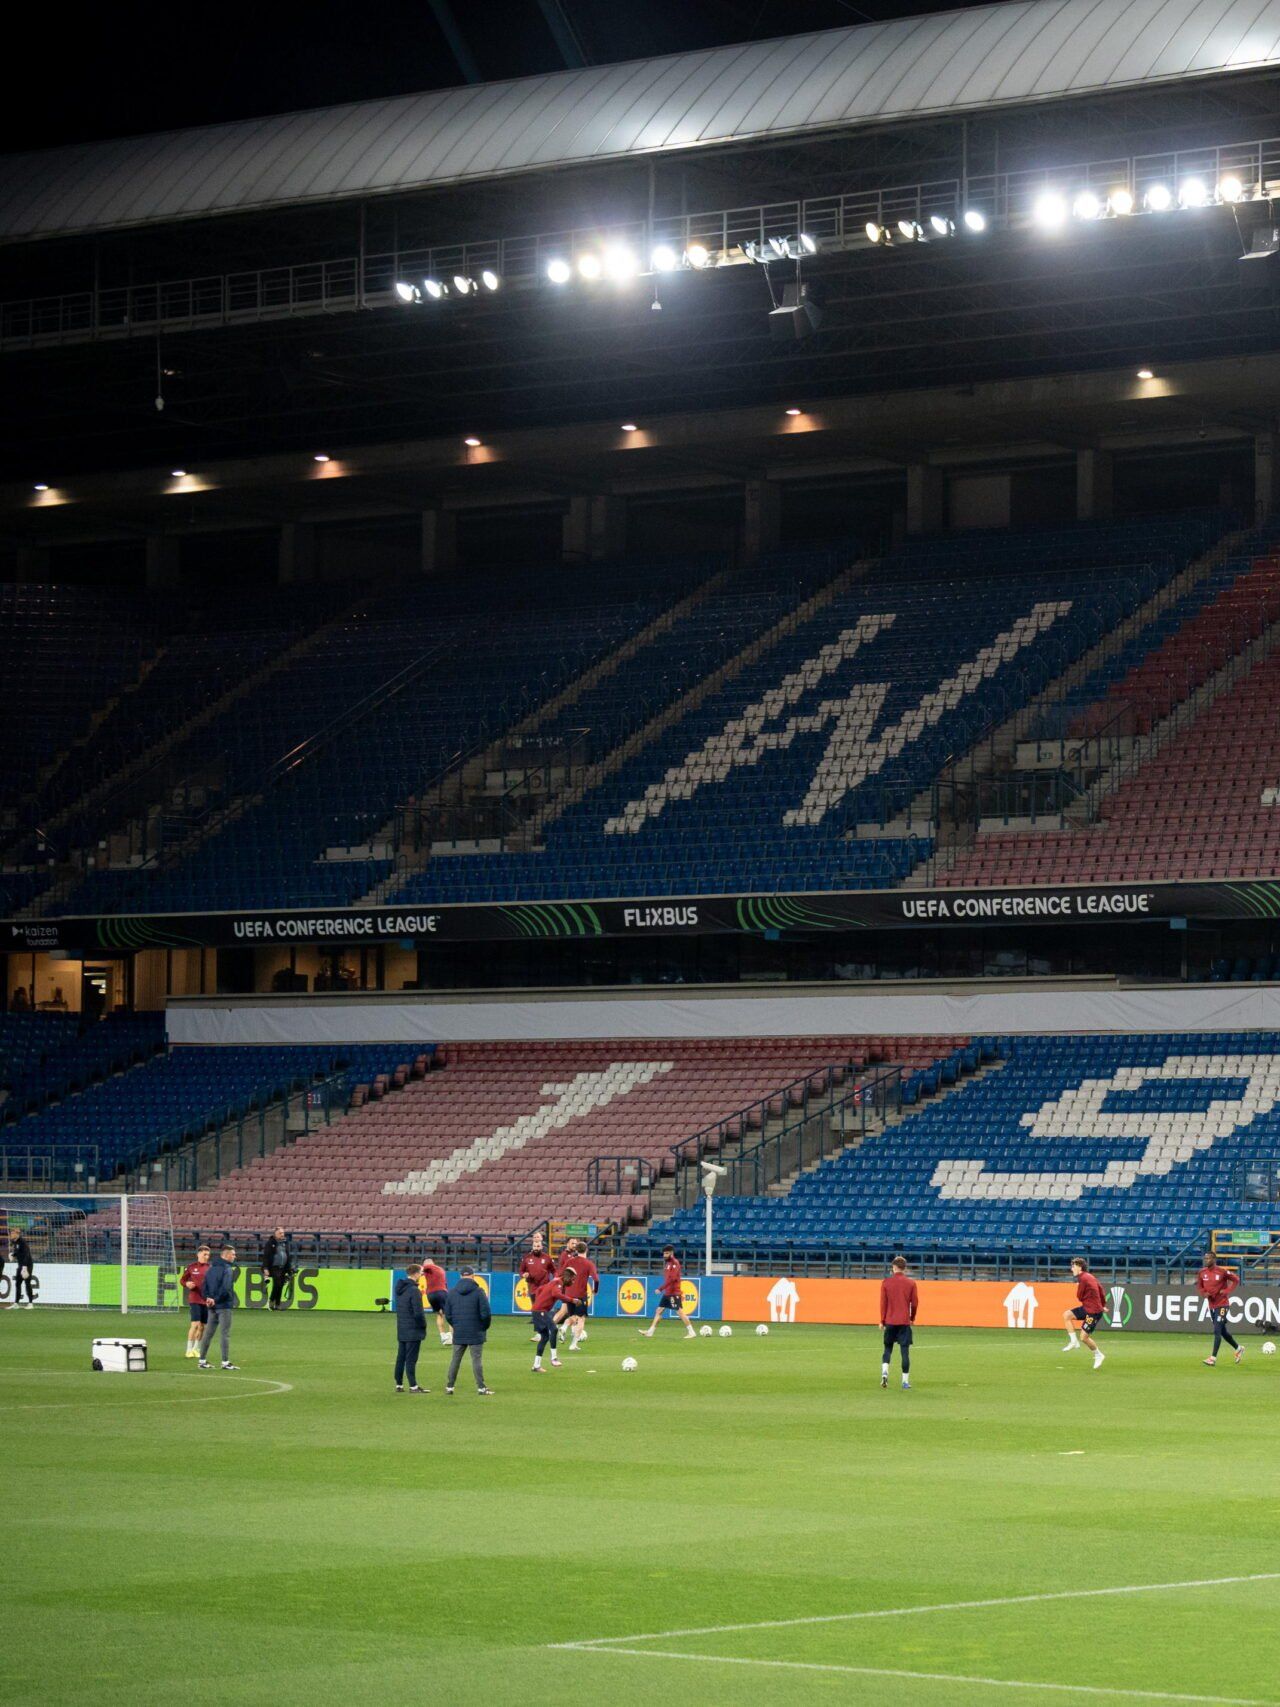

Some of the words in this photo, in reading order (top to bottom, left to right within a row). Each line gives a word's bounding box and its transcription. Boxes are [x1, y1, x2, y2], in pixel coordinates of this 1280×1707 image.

[903, 900, 950, 918] UEFA
[953, 897, 1071, 916] CONFERENCE
[25, 925, 58, 936] kaizen
[234, 921, 274, 938] UEFA
[276, 918, 374, 936] CONFERENCE
